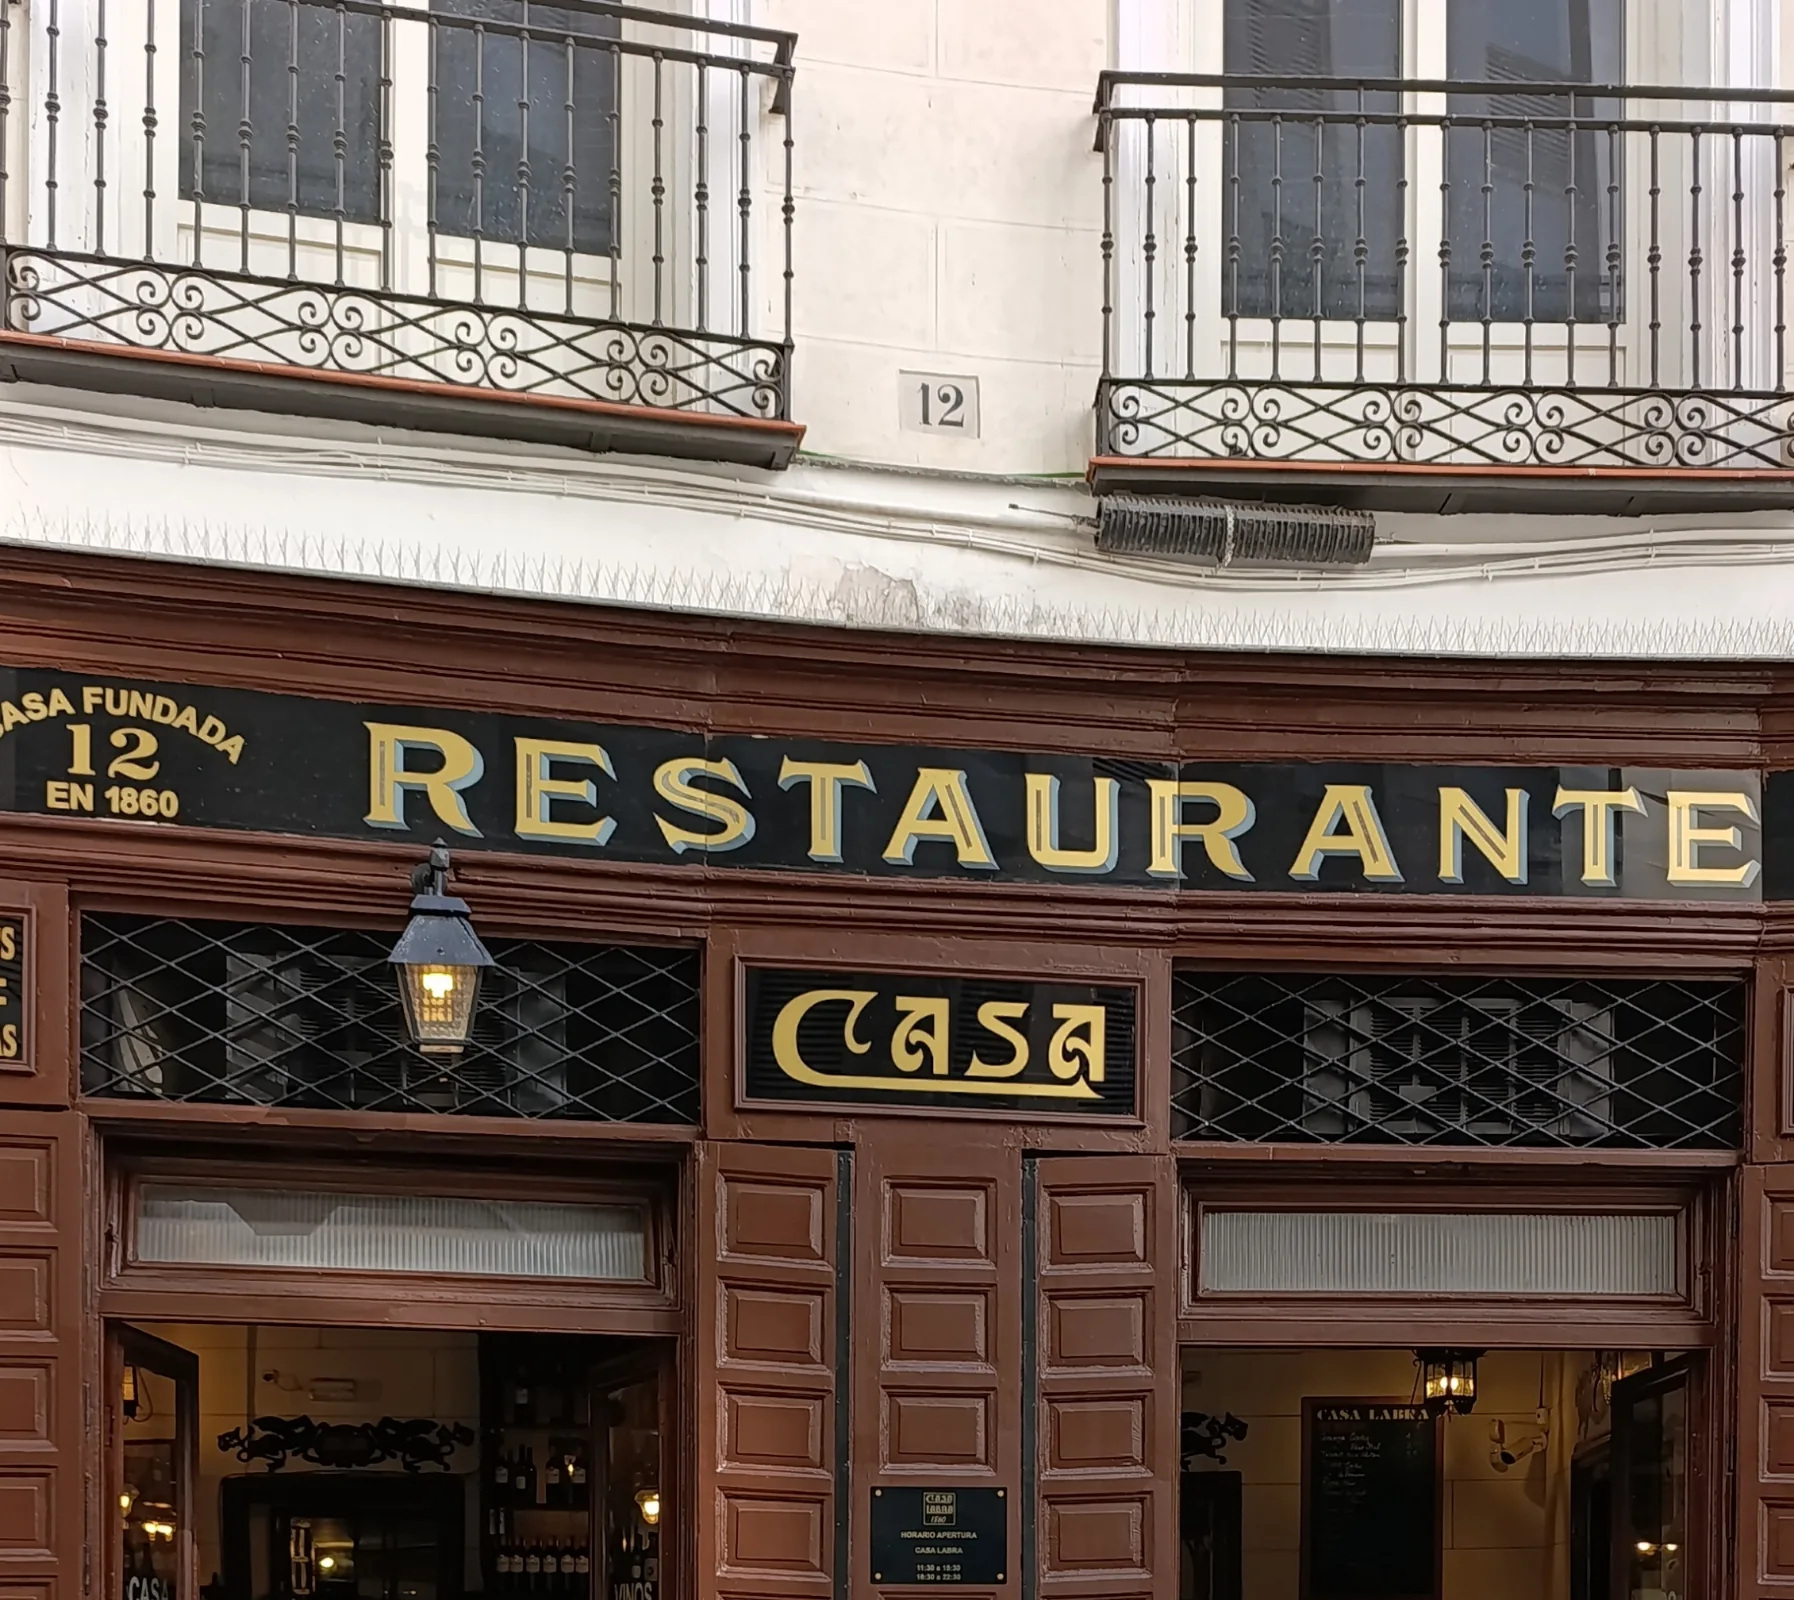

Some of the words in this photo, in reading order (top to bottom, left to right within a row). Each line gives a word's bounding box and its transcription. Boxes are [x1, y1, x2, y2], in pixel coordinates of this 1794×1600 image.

[917, 382, 965, 428] 12
[0, 688, 76, 739] ASA
[82, 686, 246, 766] FUNDADA
[66, 723, 160, 781] 12
[46, 780, 94, 812] EN
[104, 786, 180, 818] 1860
[362, 720, 1761, 888] RESTAURANTE
[772, 989, 1107, 1100] CASA
[1317, 1408, 1361, 1420] CASA
[1368, 1408, 1430, 1420] LABRA
[900, 1531, 936, 1539] HORARIO
[936, 1531, 978, 1539] APERTURA
[914, 1546, 936, 1554] CASA
[937, 1546, 964, 1554] LABRA
